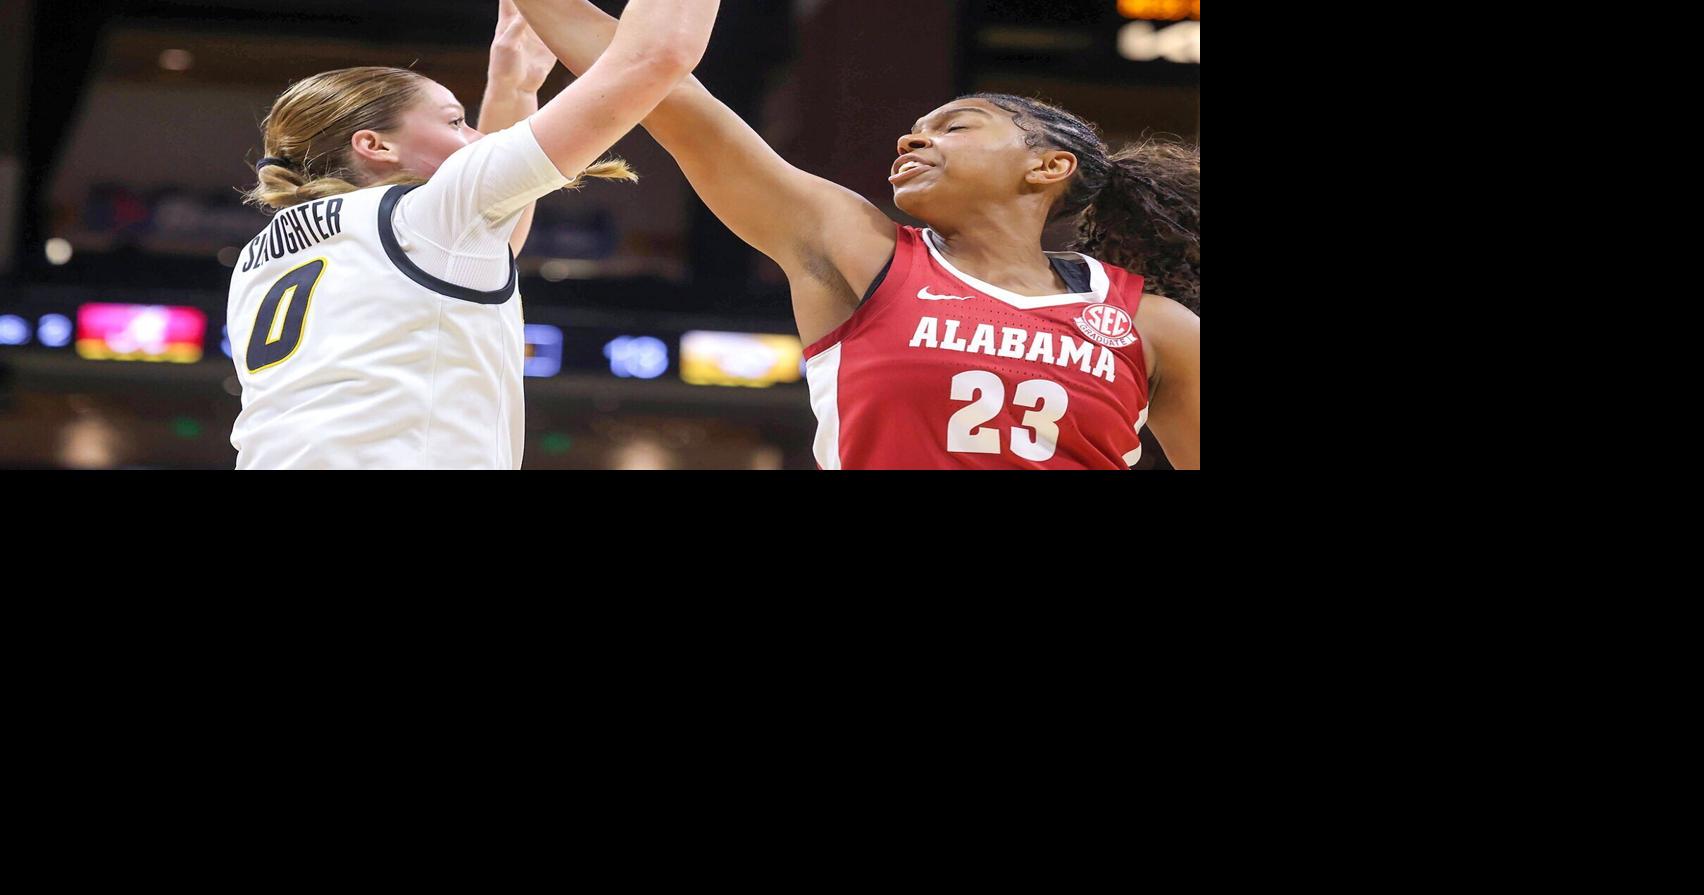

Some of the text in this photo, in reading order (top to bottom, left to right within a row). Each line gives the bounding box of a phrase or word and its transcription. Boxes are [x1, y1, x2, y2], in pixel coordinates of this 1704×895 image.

[246, 257, 328, 373] 0
[1080, 324, 1126, 346] GRADUATE
[1087, 306, 1128, 336] SEC
[909, 317, 1115, 383] ALABAMA
[947, 370, 1069, 461] 23
